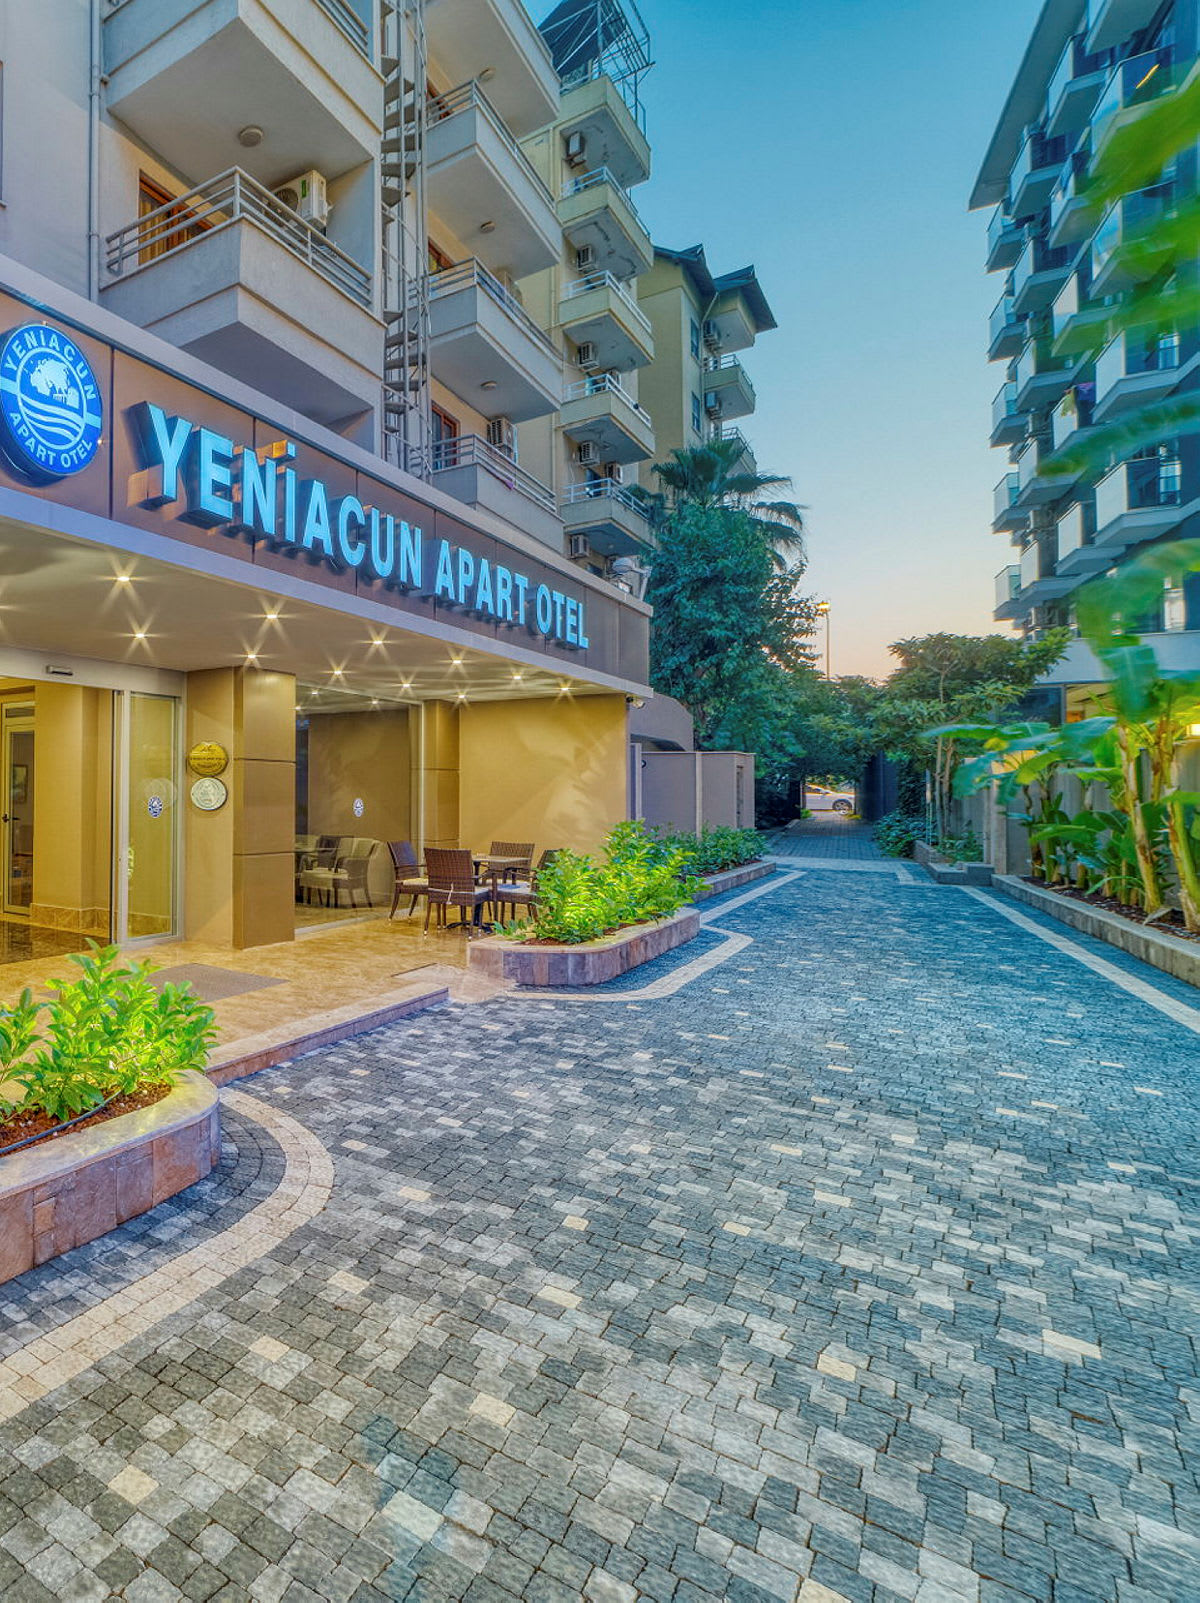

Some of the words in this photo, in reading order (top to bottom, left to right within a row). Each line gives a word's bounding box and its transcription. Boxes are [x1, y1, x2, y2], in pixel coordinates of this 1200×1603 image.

[10, 412, 56, 466] APART
[60, 439, 93, 468] OTEL
[435, 539, 528, 625] APART
[536, 583, 589, 649] OTEL
